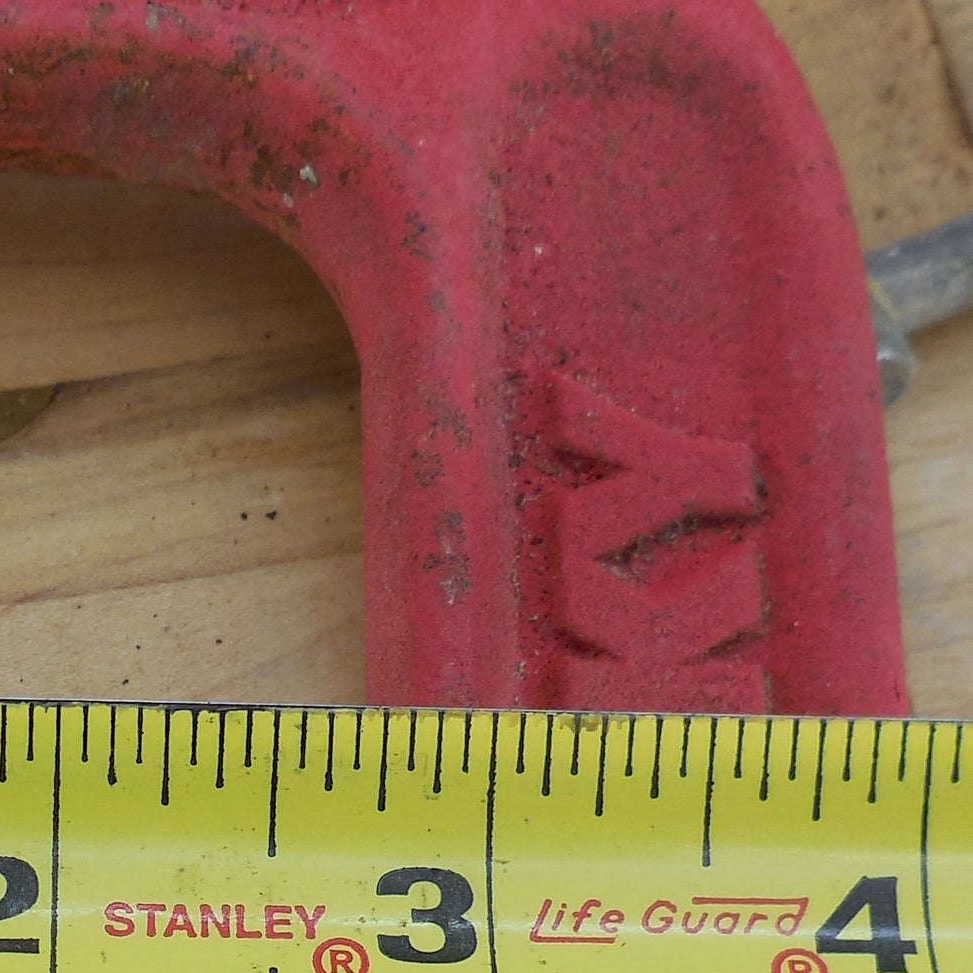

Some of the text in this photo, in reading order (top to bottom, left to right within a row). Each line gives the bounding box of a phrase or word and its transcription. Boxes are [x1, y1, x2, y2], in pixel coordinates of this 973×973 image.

[104, 901, 327, 940] STANLEY
[376, 866, 478, 964] 3
[530, 898, 626, 944] Life
[641, 896, 810, 937] Guard
